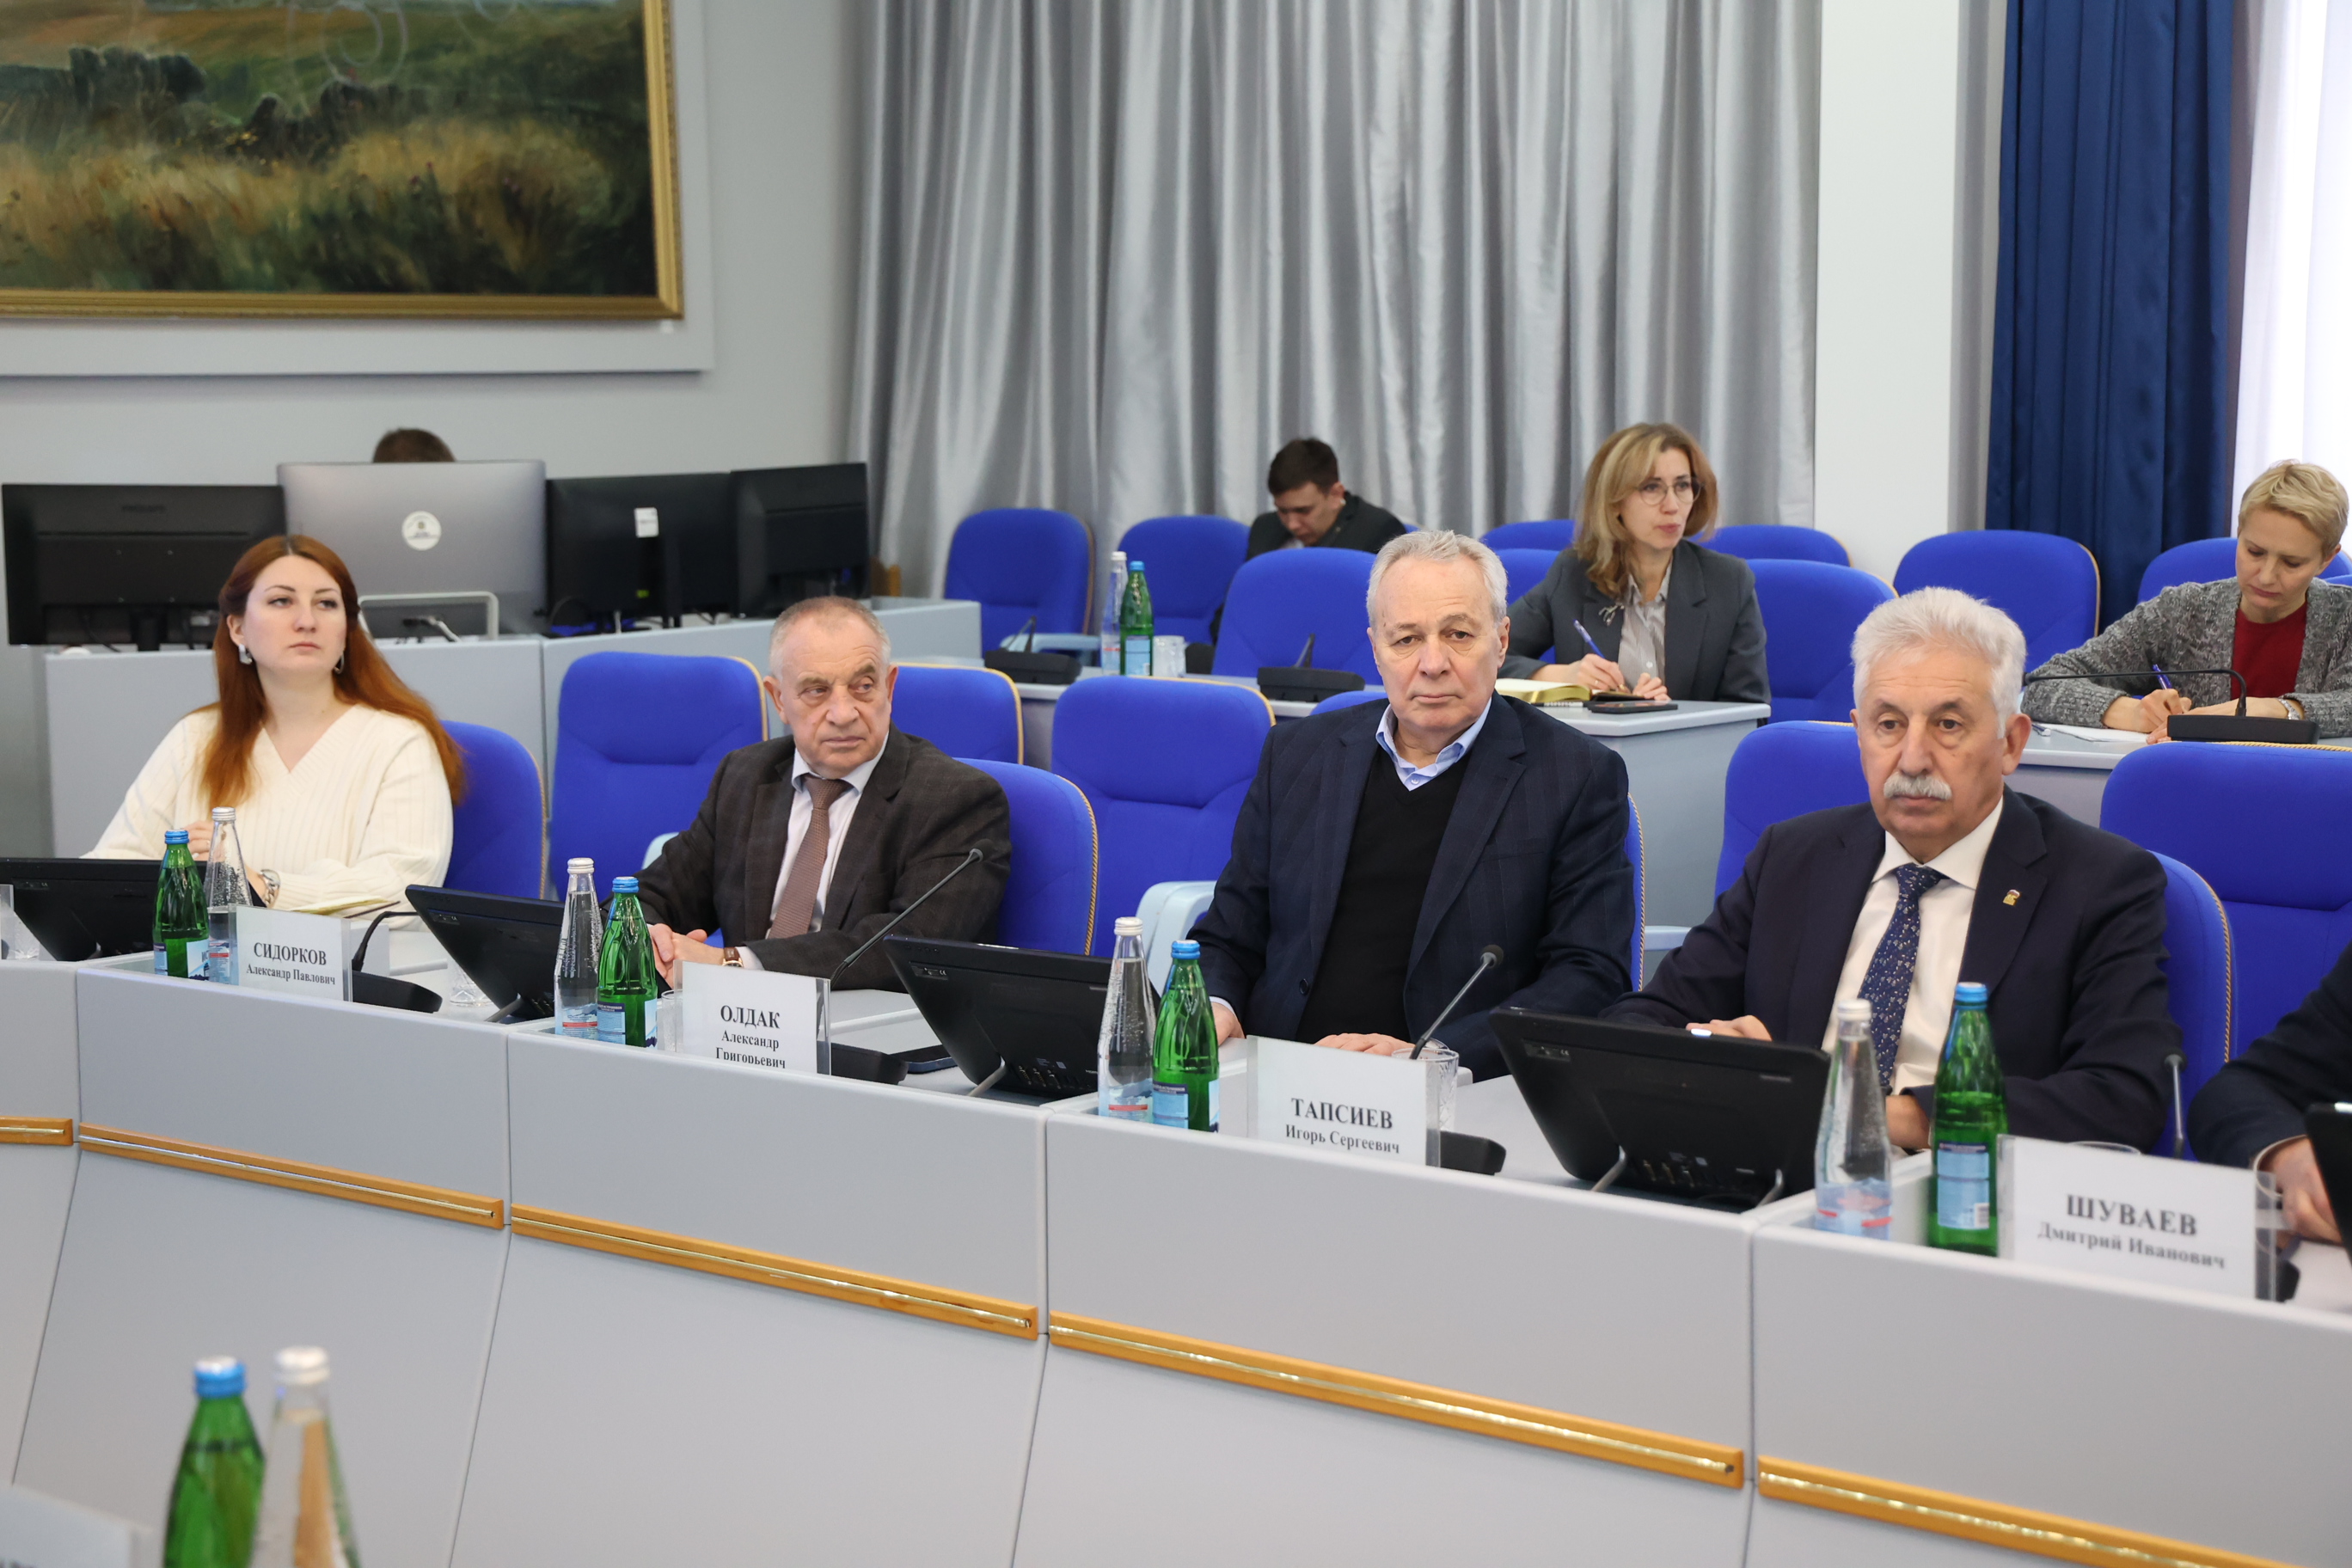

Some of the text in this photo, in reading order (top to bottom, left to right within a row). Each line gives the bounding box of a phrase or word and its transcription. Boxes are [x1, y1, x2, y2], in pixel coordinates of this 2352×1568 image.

[253, 941, 328, 966] СИДОРКОВ
[246, 964, 336, 985] Александр Павлович
[720, 1005, 781, 1029] ОЛДАК
[721, 1030, 780, 1052] Александр
[1290, 1098, 1393, 1130] ТАПСИЕВ
[1285, 1124, 1400, 1154] Игорь Сергеевич
[2066, 1193, 2198, 1236] ШУВАЕВ
[2037, 1221, 2226, 1270] Дмитрий Иванович
